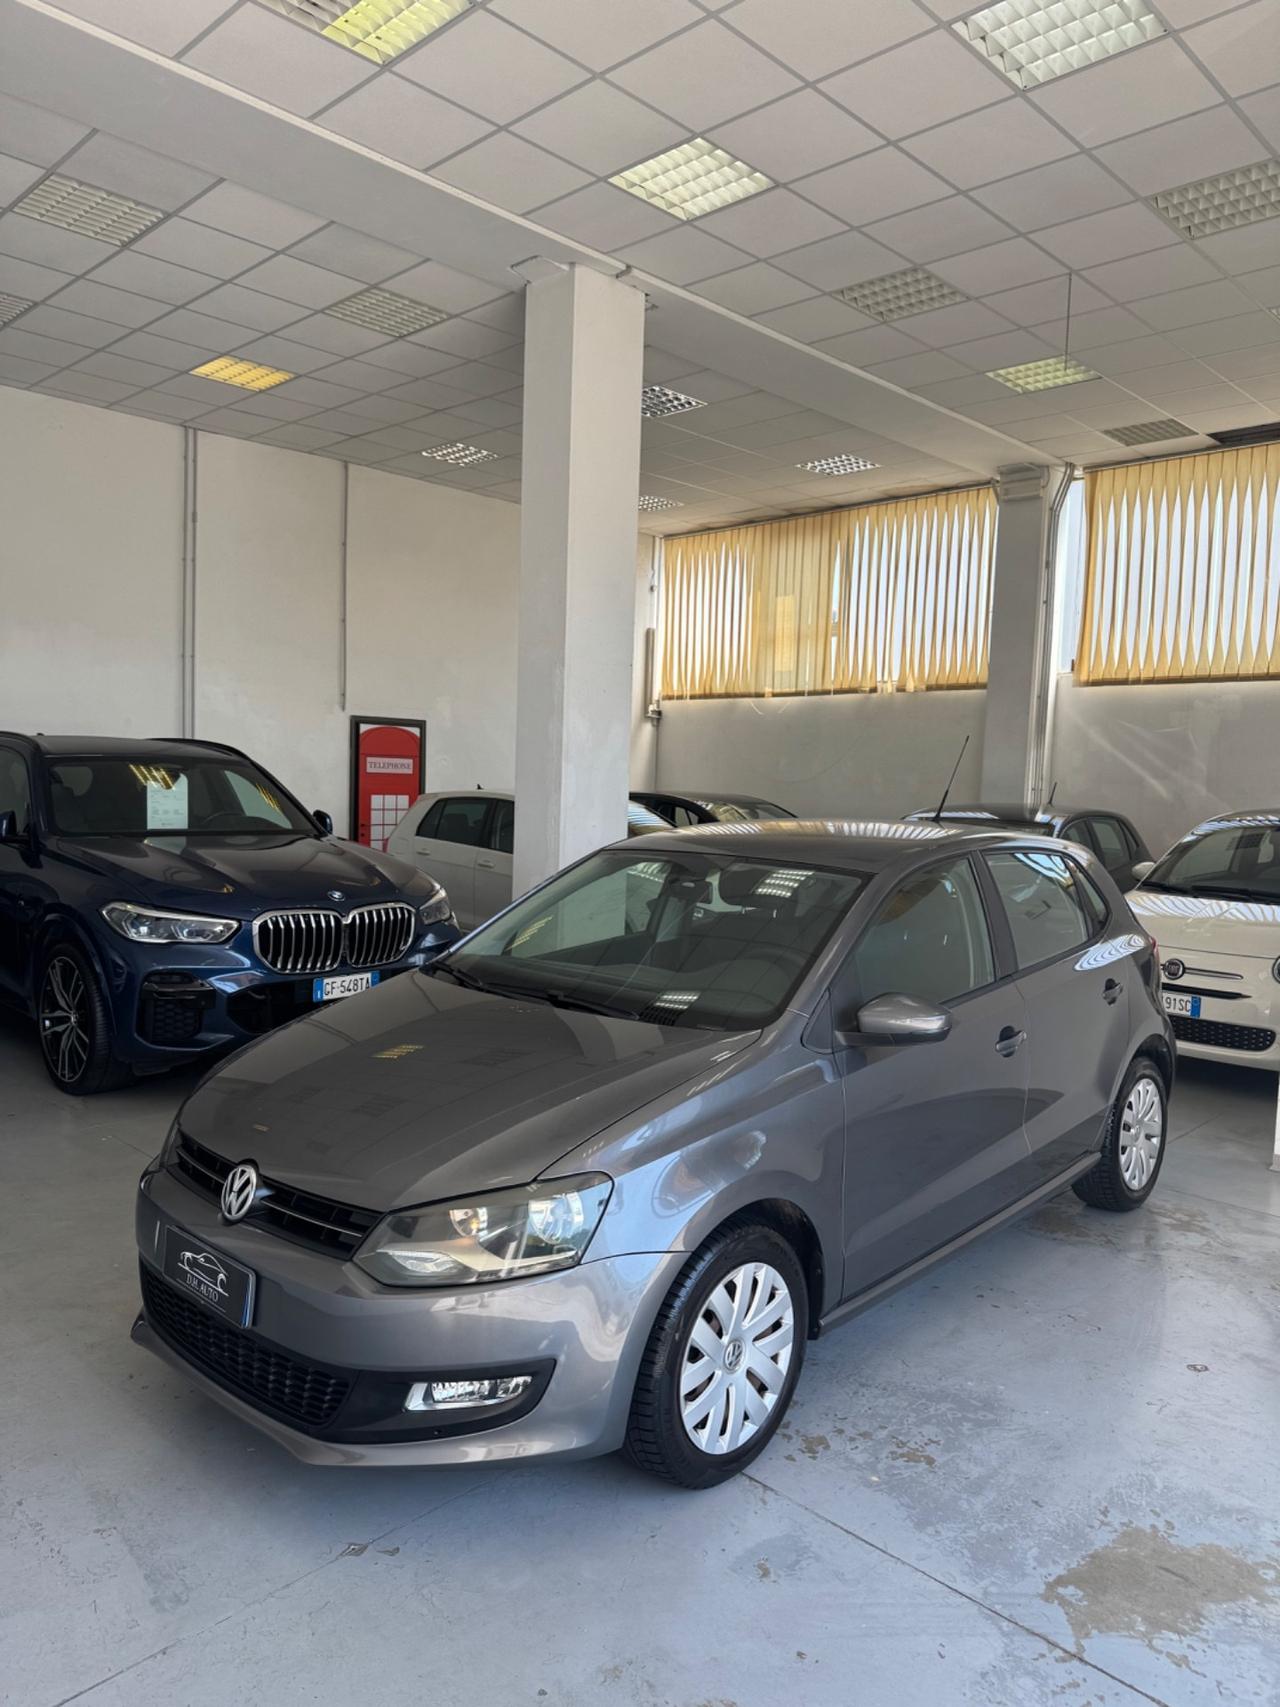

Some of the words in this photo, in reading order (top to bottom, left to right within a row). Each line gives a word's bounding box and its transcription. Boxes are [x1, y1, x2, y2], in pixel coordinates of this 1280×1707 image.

[368, 761, 411, 770] TELEPHONE
[340, 977, 370, 994] 548TA
[1162, 996, 1191, 1012] 91SC
